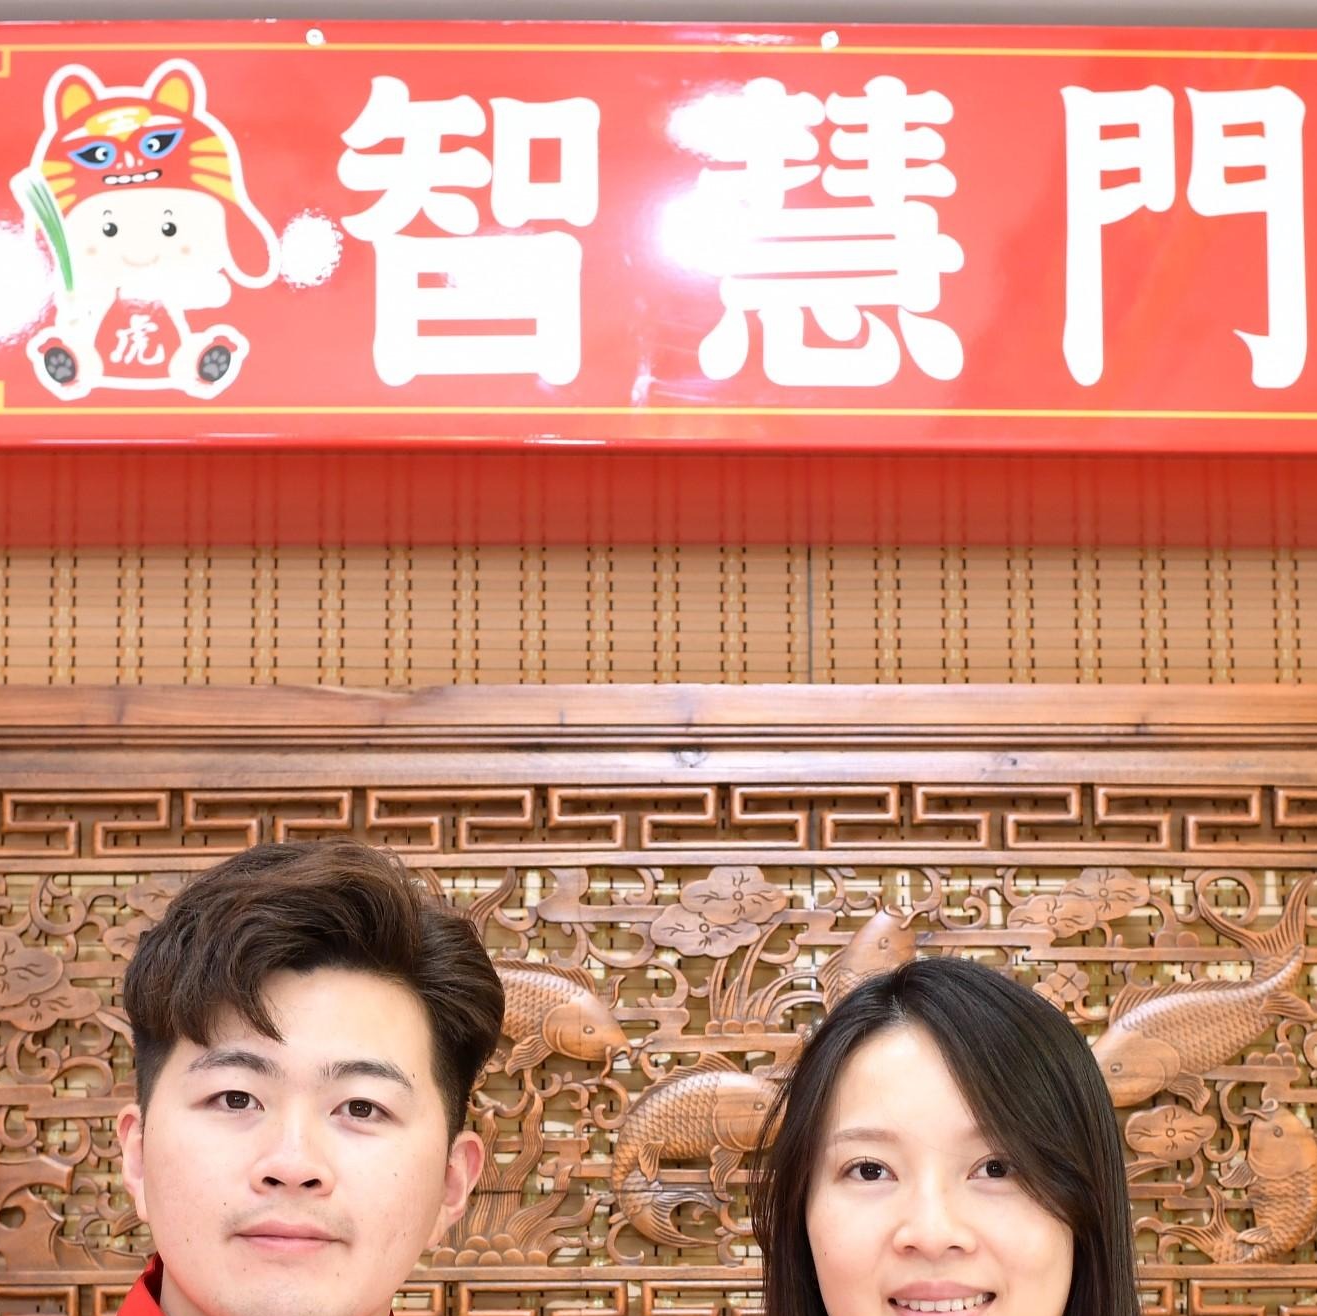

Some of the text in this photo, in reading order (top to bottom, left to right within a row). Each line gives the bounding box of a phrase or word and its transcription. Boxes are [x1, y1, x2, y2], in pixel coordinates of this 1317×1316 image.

[336, 73, 1308, 389] 智慧門
[109, 313, 166, 365] 虎
